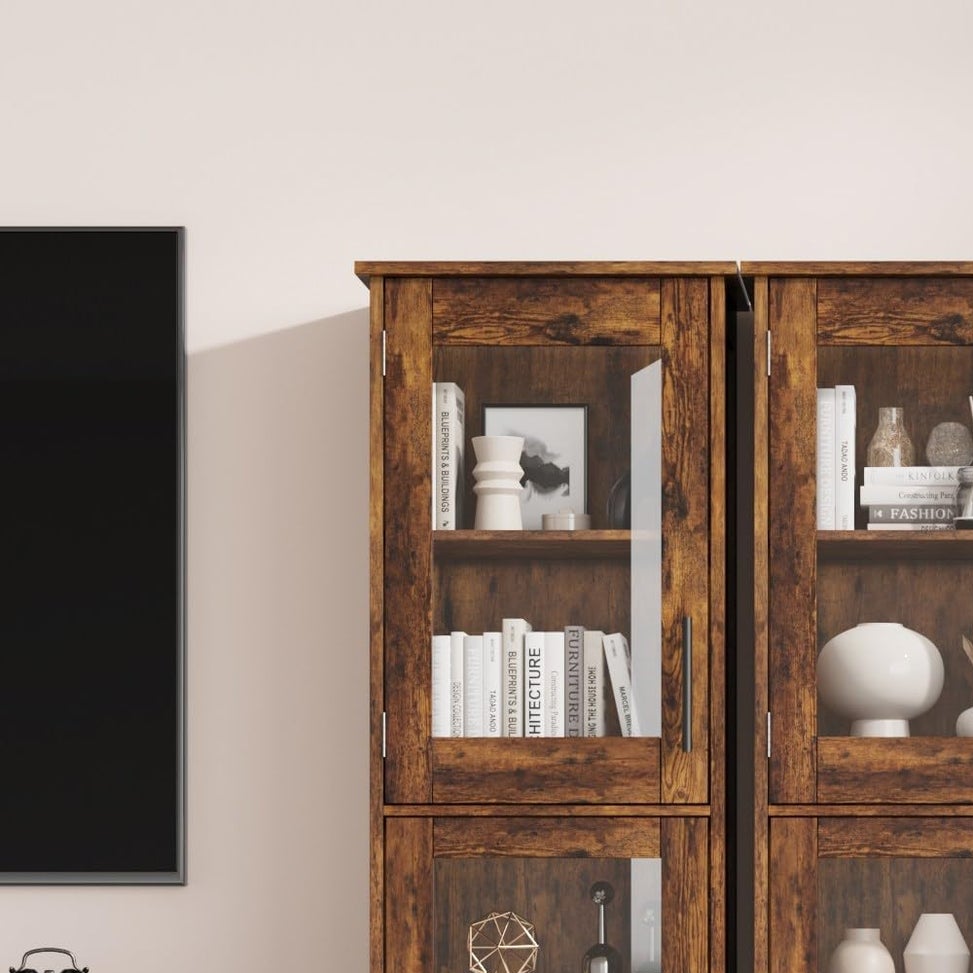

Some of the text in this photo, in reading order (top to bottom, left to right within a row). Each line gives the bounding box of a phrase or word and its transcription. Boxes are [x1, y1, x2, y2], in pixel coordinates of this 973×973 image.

[441, 411, 450, 462] BLUEPRINTS
[441, 470, 450, 513] BUILDINGS
[908, 472, 955, 481] KINFOLK
[508, 651, 517, 707] BLUEPRINTS
[528, 647, 541, 737] HITECTURE
[568, 628, 580, 723] FURNITURE
[587, 666, 597, 685] HOME
[587, 686, 597, 706] HOUSE
[489, 690, 497, 733] TADAO ANDO
[587, 706, 597, 721] THE
[619, 686, 629, 713] MARCEL
